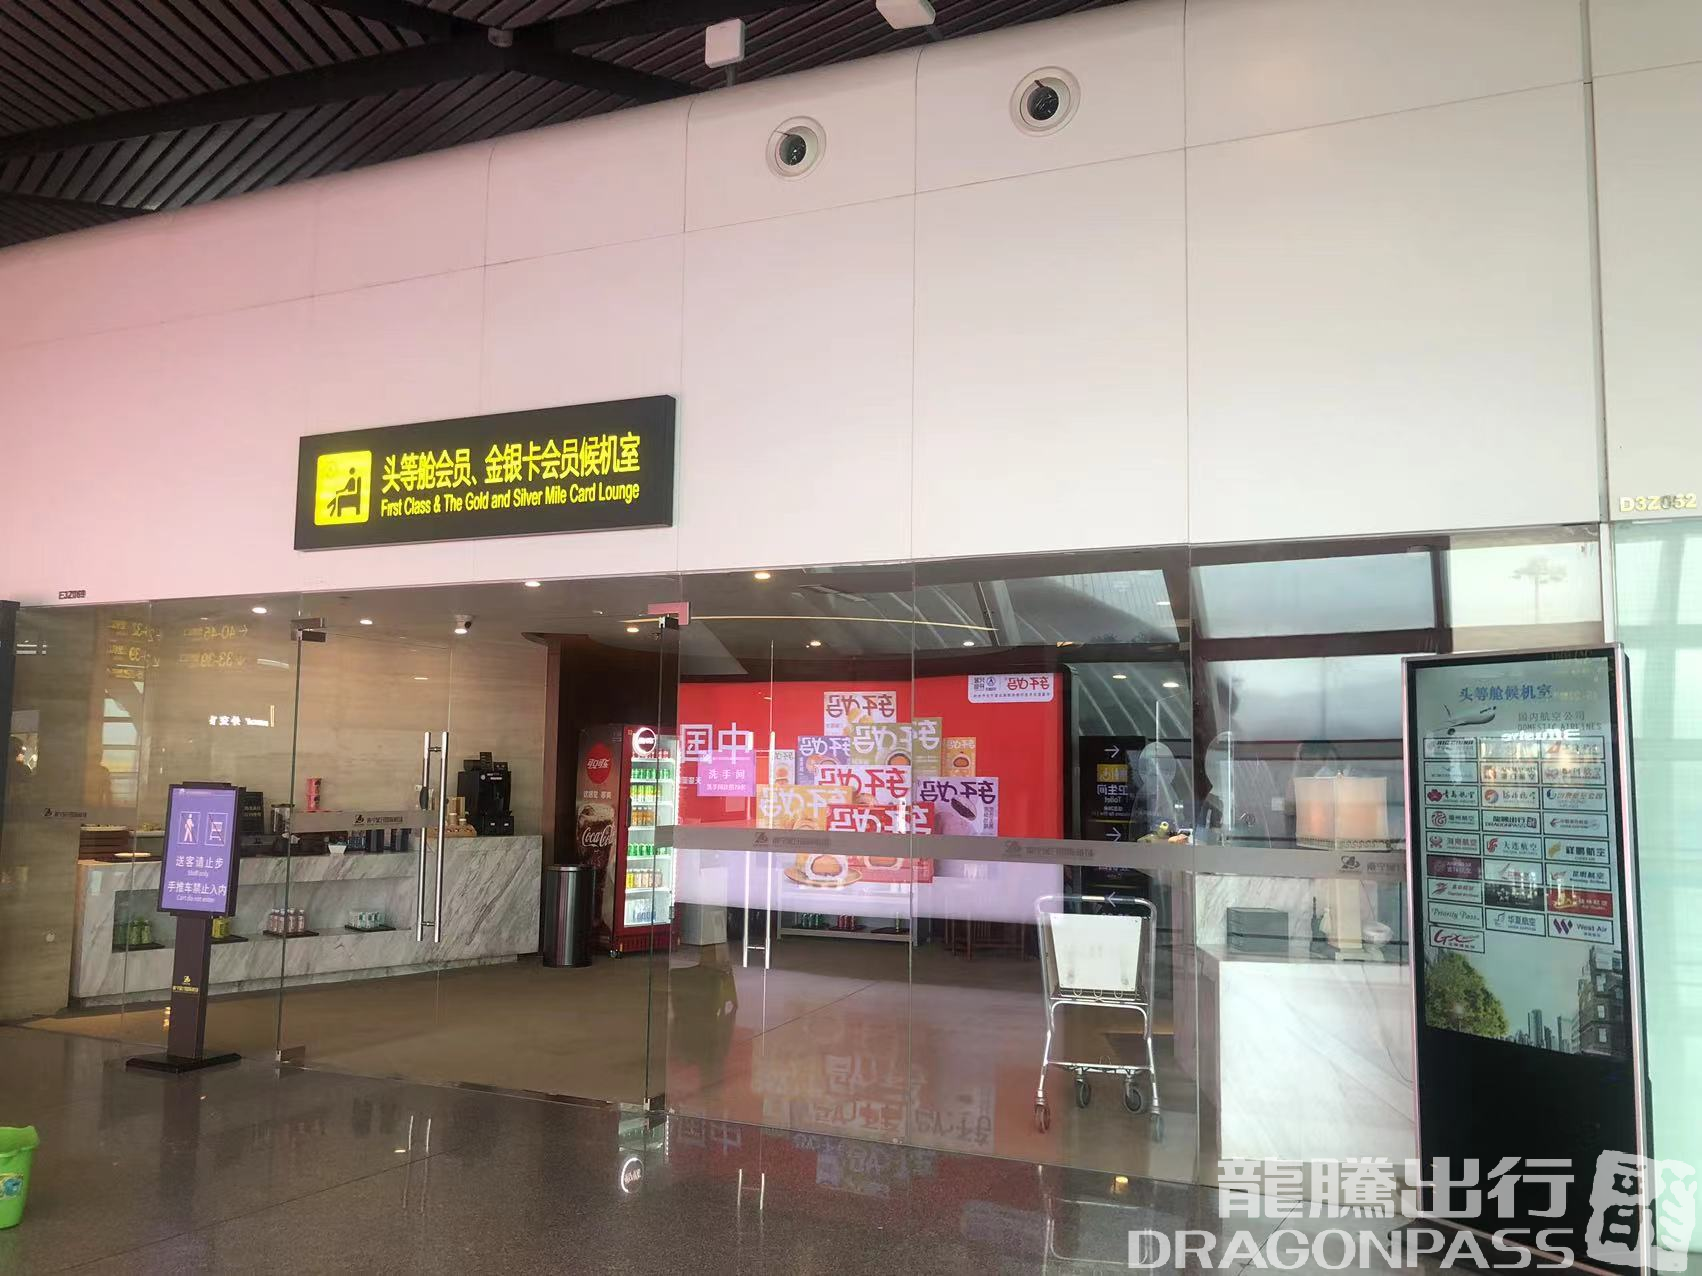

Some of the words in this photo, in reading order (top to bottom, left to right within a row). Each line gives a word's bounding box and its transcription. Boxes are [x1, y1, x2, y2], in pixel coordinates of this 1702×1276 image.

[381, 431, 641, 494] 头等舱会员、金银卡会员候机室
[381, 498, 402, 517] First
[404, 497, 431, 516] Class
[433, 494, 441, 513] &
[444, 493, 463, 512] The
[465, 491, 490, 511] Gold
[491, 489, 511, 509] and
[513, 487, 543, 508] Silver
[545, 485, 568, 505] Mile
[569, 482, 597, 503] Card
[598, 481, 640, 505] Lounge
[1619, 493, 1696, 512] D3Z052
[1460, 684, 1552, 701] 头等舱候机室
[1518, 711, 1585, 722] 国内航空公司
